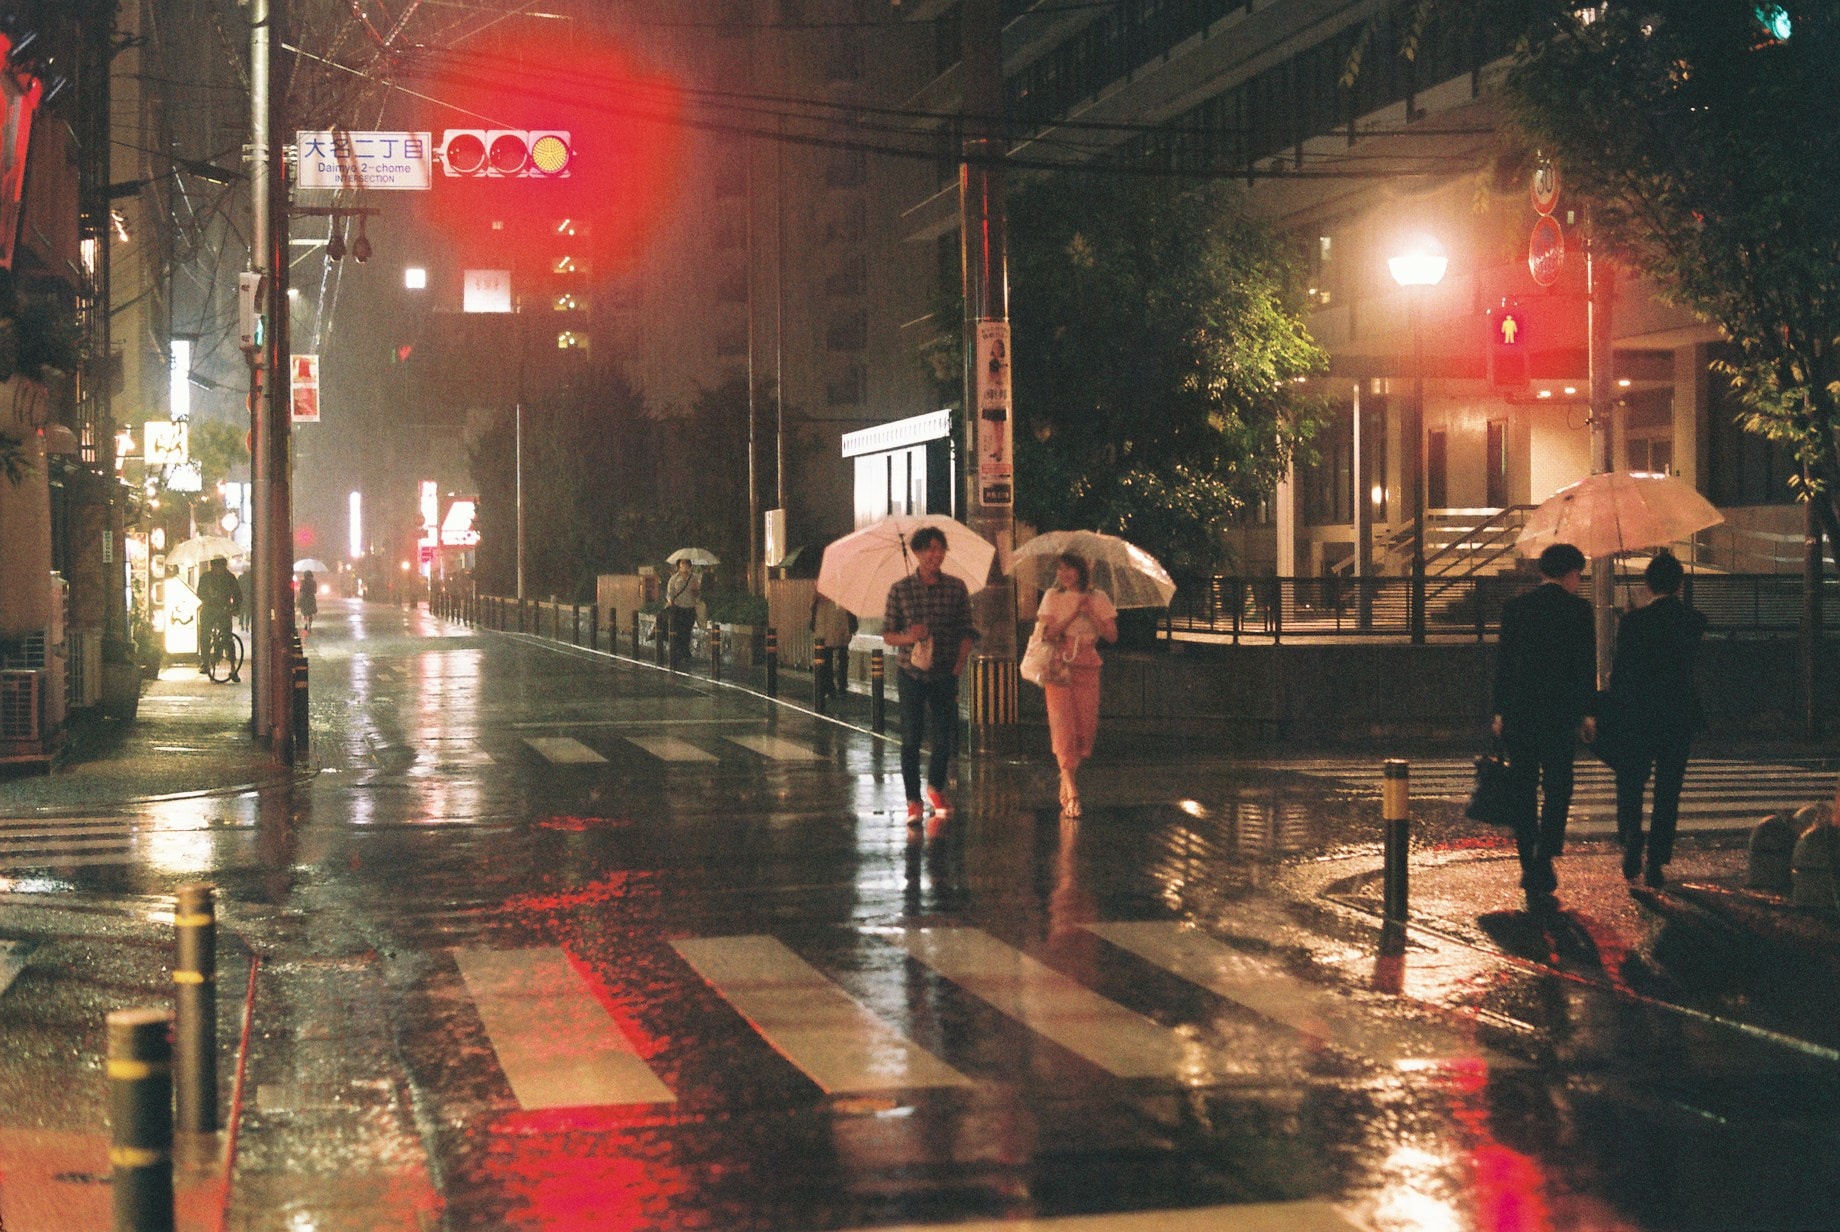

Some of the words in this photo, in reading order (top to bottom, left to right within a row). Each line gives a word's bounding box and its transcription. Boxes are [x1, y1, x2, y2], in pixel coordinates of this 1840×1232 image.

[304, 138, 423, 159] 大名二丁目
[318, 162, 356, 175] Daimyo
[361, 163, 411, 173] 2-chome
[334, 175, 395, 183] INTERSECTION
[1536, 164, 1554, 195] 30
